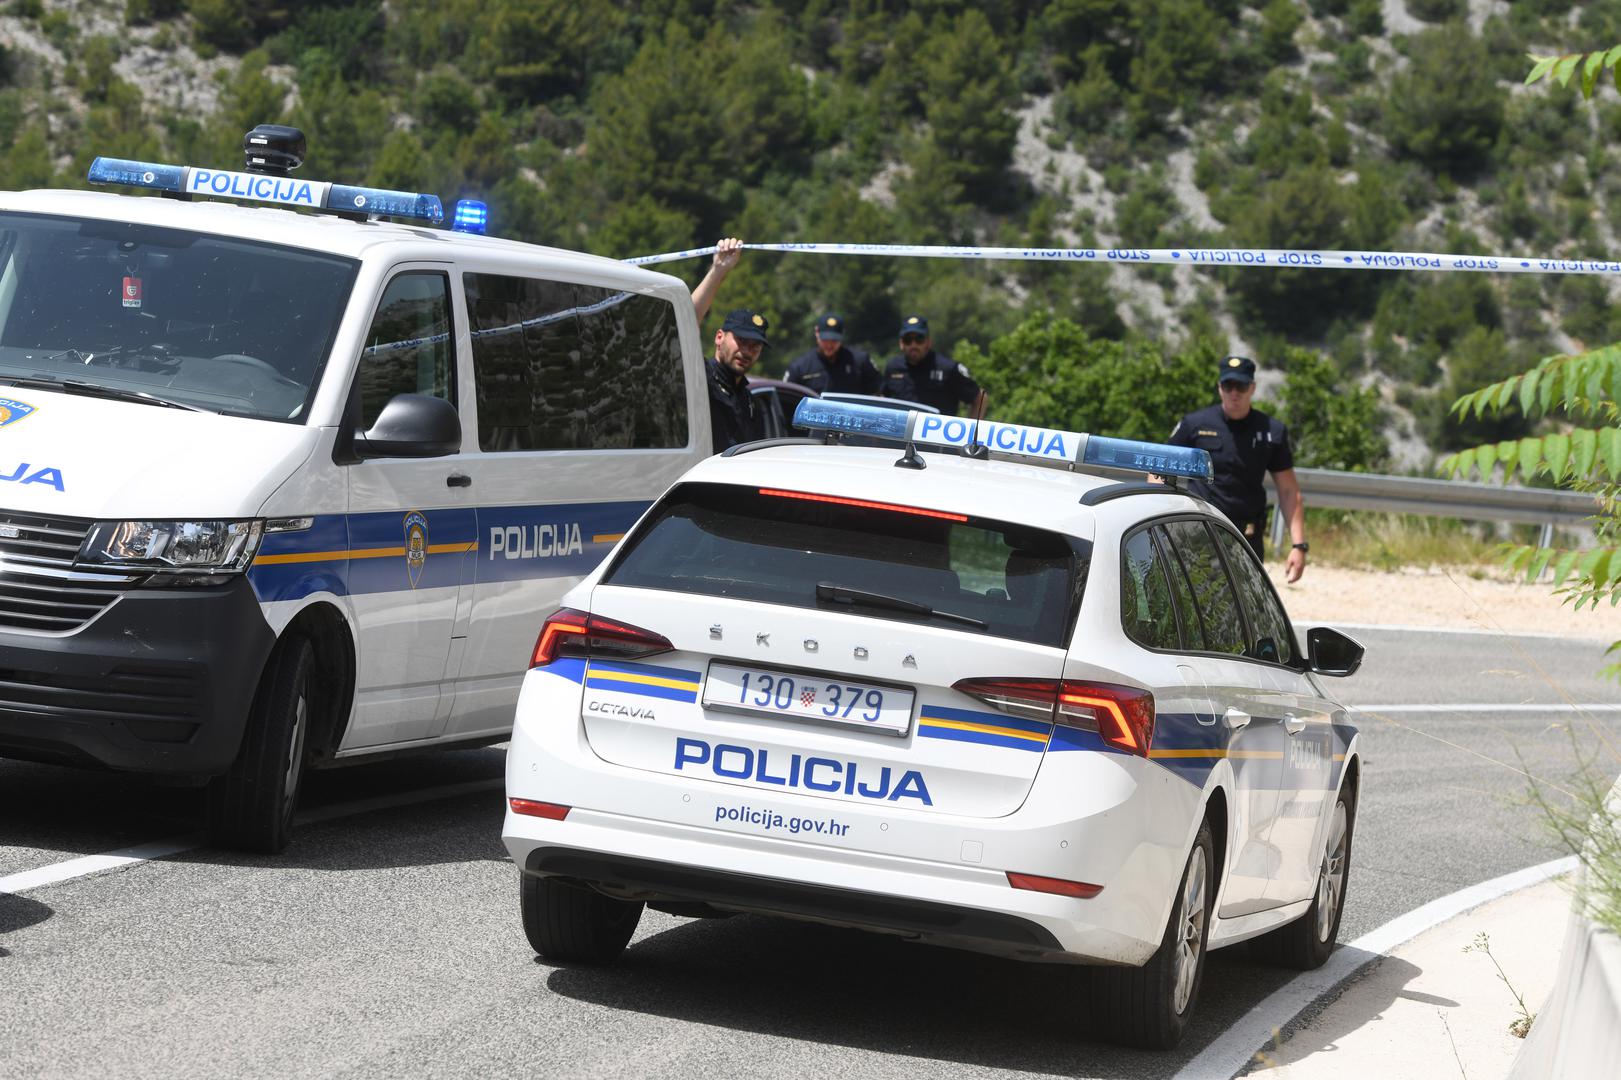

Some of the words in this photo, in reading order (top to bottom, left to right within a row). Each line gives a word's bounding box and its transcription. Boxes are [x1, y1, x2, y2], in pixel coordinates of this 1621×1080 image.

[193, 171, 312, 203] POLICIJA
[1107, 249, 1151, 260] STOP
[1188, 250, 1267, 264] POLICIJA
[1278, 252, 1323, 265] STOP
[1361, 254, 1442, 267] POLICIJA
[1453, 258, 1499, 269] STOP
[921, 415, 1066, 457] POLICIJA
[489, 522, 583, 560] POLICIJA
[740, 672, 795, 709] 130
[822, 684, 883, 722] 379
[588, 701, 656, 720] OCTAVIA
[673, 737, 934, 806] POLICIJA
[715, 806, 850, 837] policija.gov.hr
